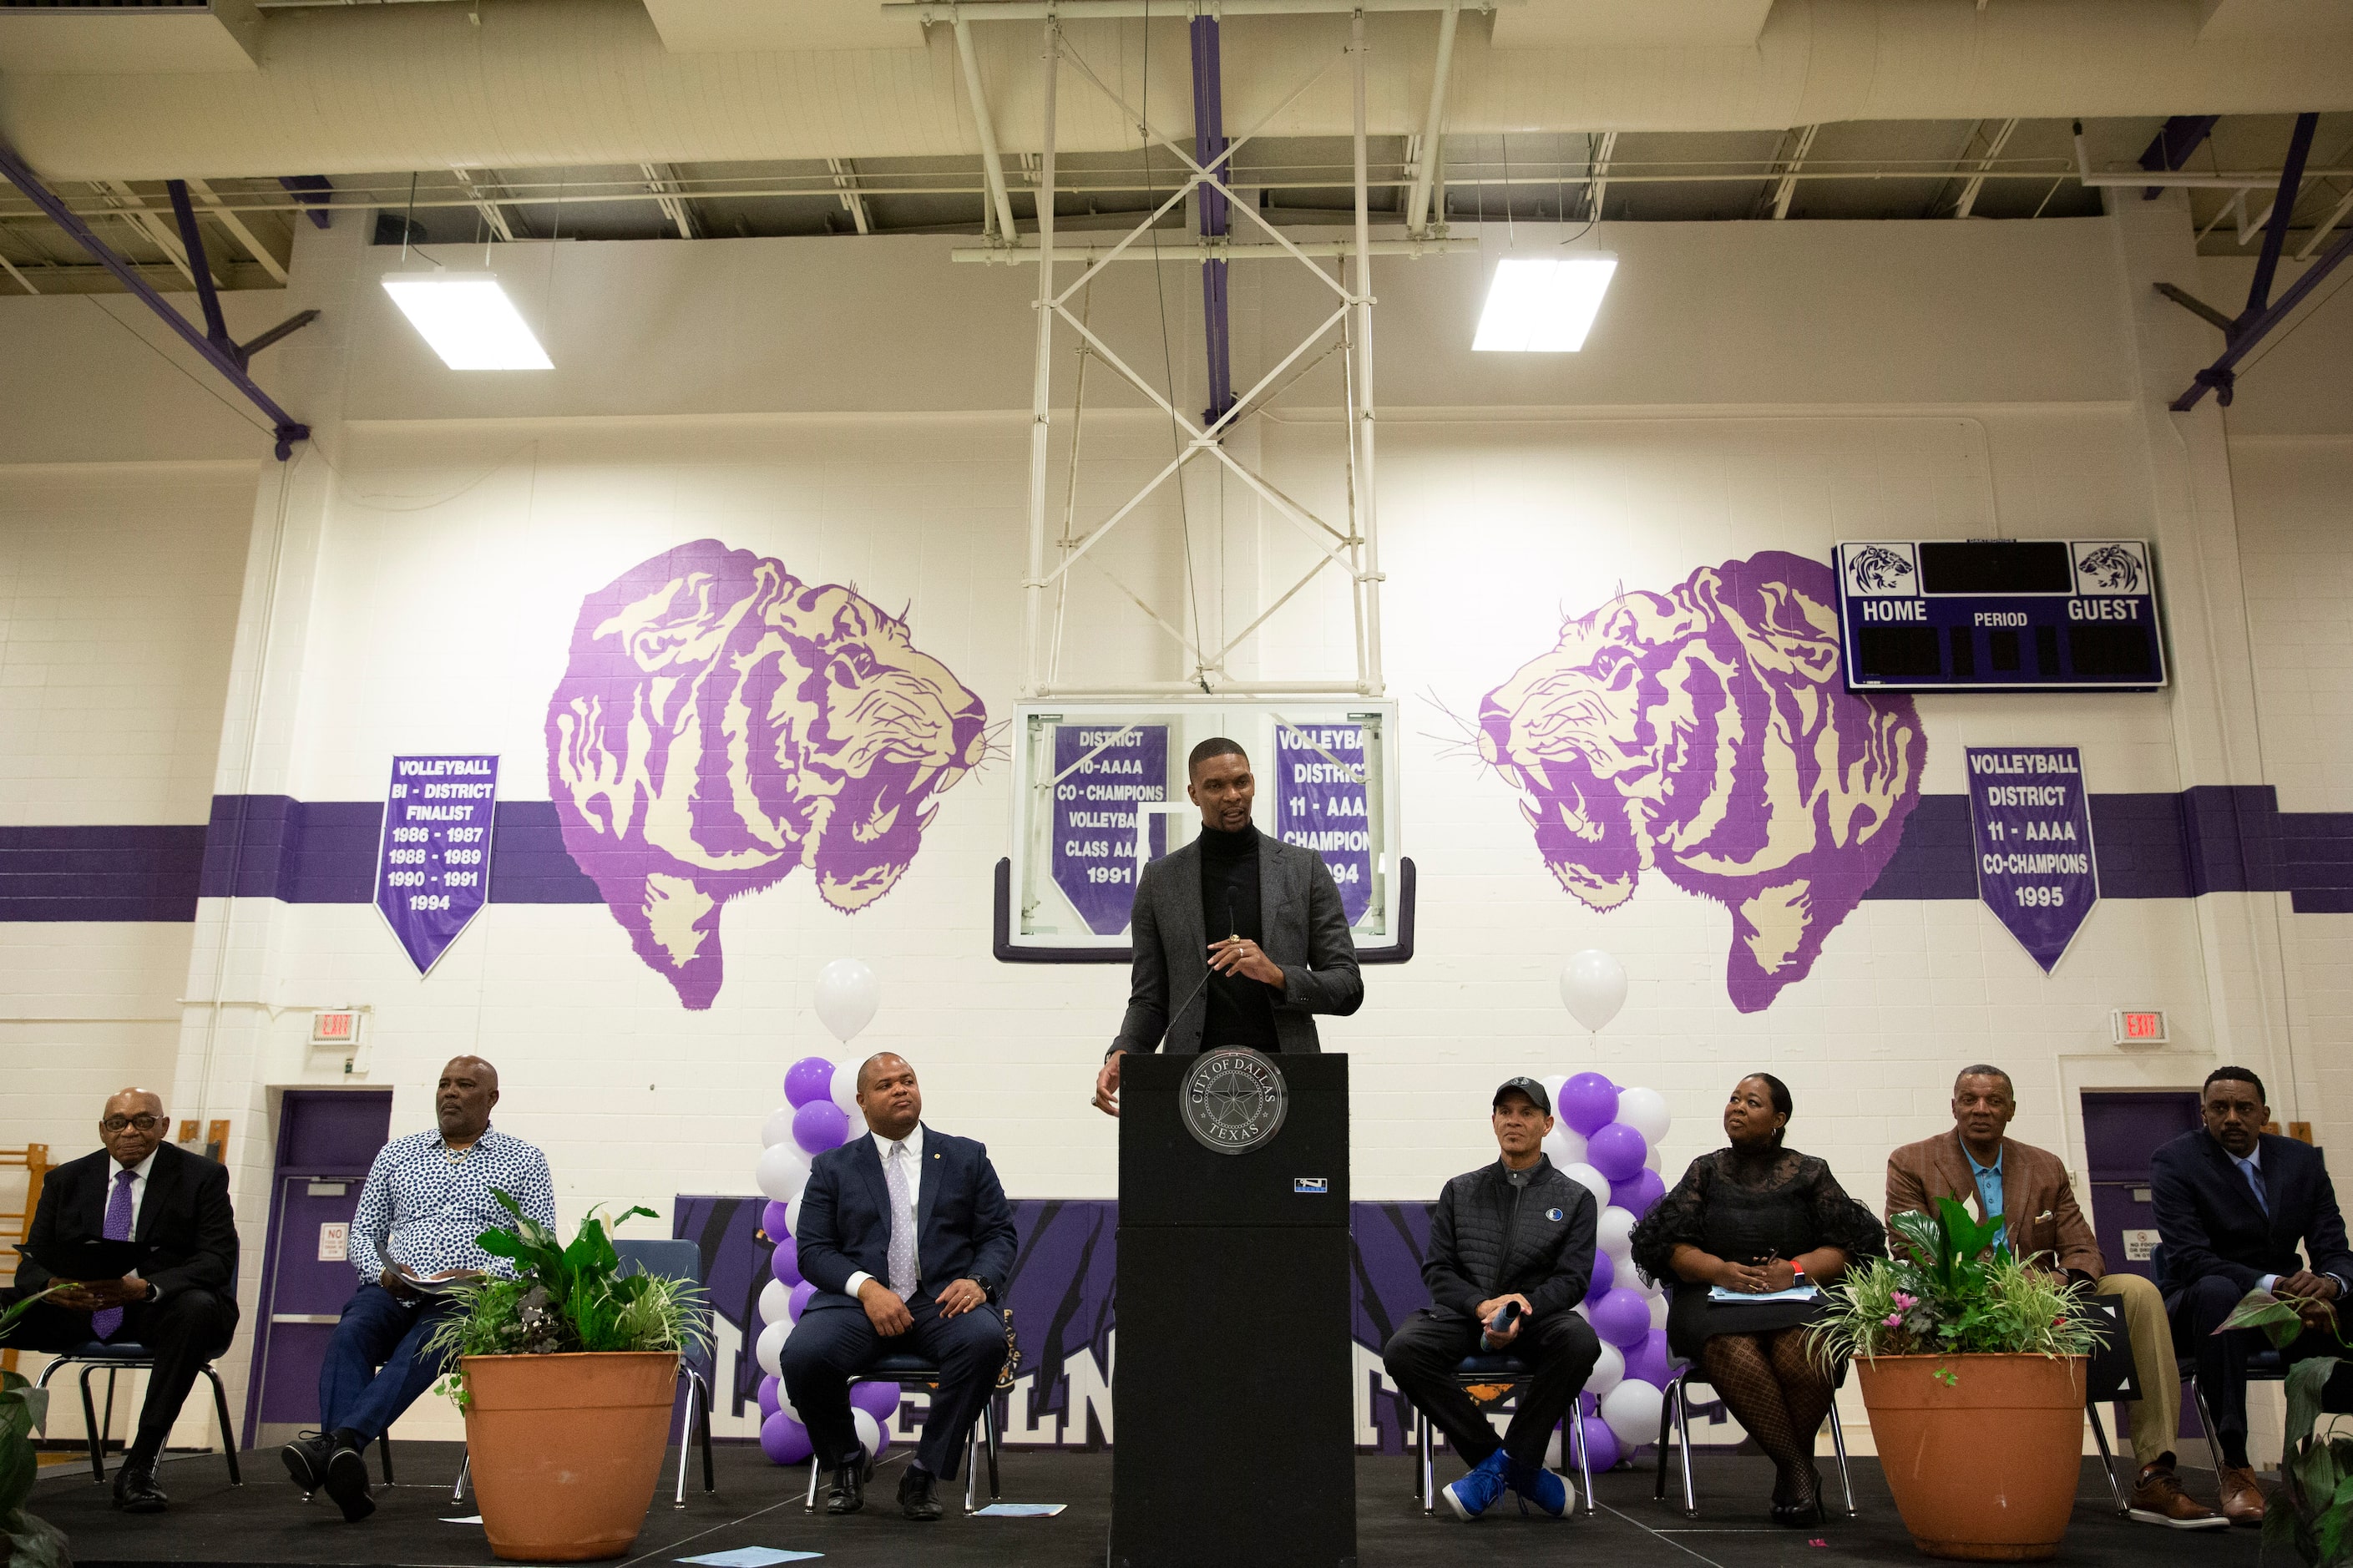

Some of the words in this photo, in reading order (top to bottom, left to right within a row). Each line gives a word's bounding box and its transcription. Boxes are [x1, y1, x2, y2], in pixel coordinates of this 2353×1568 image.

[1863, 600, 1927, 621] HOME
[2067, 599, 2139, 620] GUEST
[1974, 613, 2027, 626] PERIOD
[1279, 730, 1364, 750] VOLLEYBA
[399, 760, 491, 776] VOLLEYBALL
[1294, 763, 1365, 783] DISTRIC
[1971, 754, 2077, 774] VOLLEYBALL
[392, 784, 407, 799] BI
[424, 784, 493, 799] DISTRICT
[1057, 784, 1077, 801] CO
[1086, 784, 1164, 801] CHAMPIONS
[1987, 787, 2066, 806] DISTRICT
[407, 806, 473, 821] FINALIST
[1289, 797, 1306, 817] 11
[1327, 797, 1368, 817] AAA
[1069, 812, 1150, 828] VOLLEYBA
[392, 827, 429, 842] 1986
[447, 827, 483, 842] 1987
[1987, 822, 2004, 841] 11
[2026, 822, 2076, 841] AAAA
[389, 849, 426, 864] 1988
[444, 849, 481, 864] 1989
[1065, 840, 1109, 857] CLASS
[1982, 853, 2087, 874] CO-CHAMPIONS
[387, 872, 425, 887] 1990
[443, 872, 478, 887] 1991
[1087, 867, 1131, 884] 1991
[409, 895, 450, 910] 1994
[2016, 887, 2064, 907] 1995
[322, 1014, 351, 1035] EXIT
[2127, 1014, 2156, 1036] EXIT
[1192, 1070, 1212, 1104] CITY
[1212, 1059, 1230, 1073] OF
[1234, 1059, 1275, 1103] DALLAS
[1209, 1123, 1259, 1141] TEXAS
[328, 1229, 342, 1238] NO
